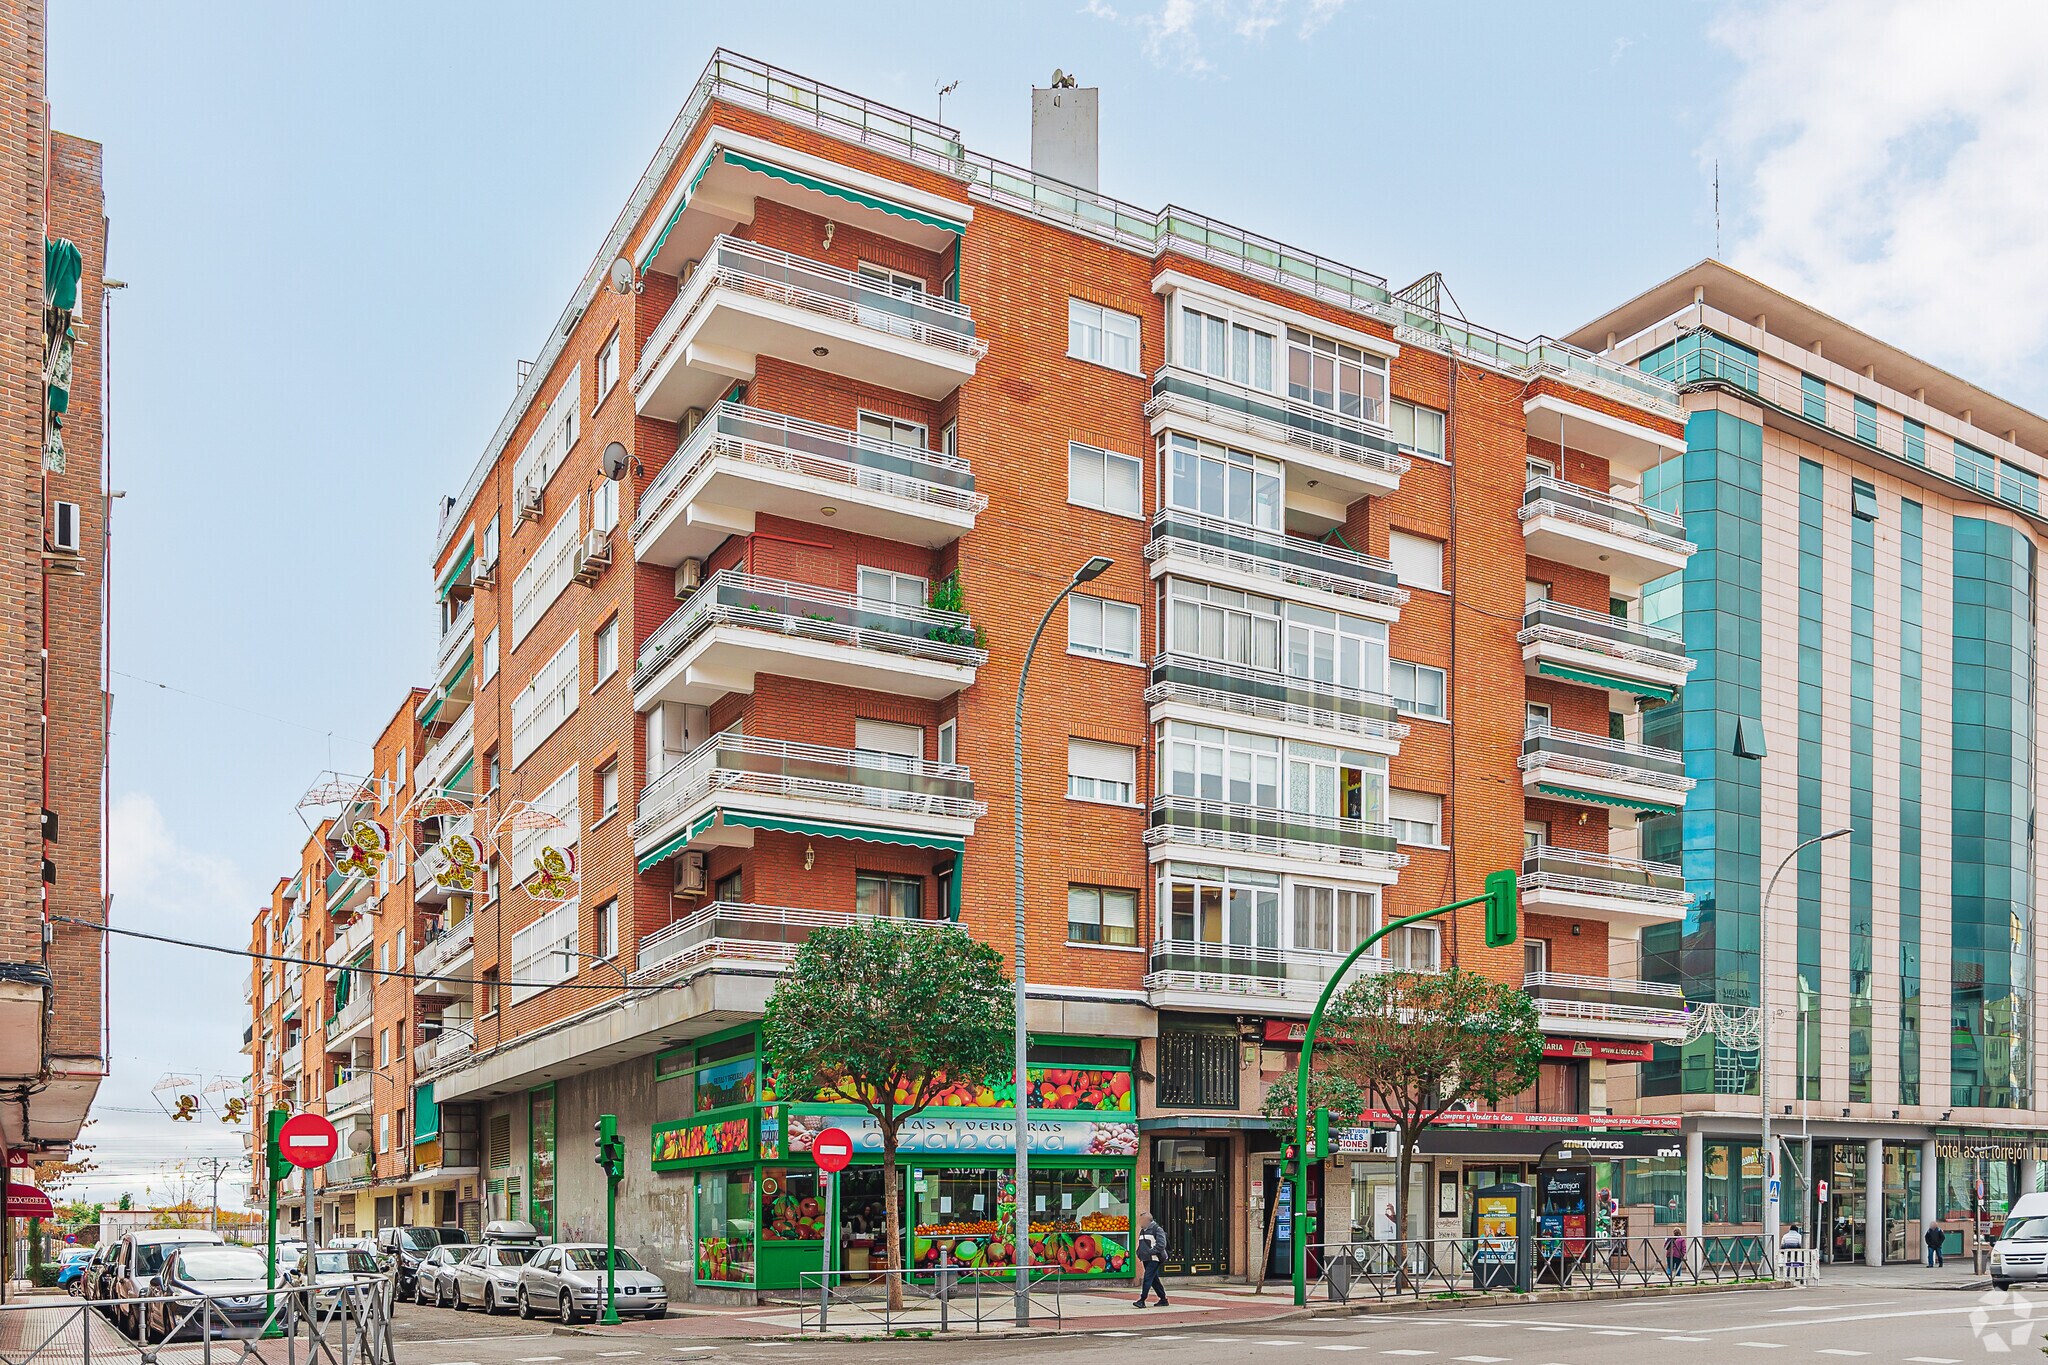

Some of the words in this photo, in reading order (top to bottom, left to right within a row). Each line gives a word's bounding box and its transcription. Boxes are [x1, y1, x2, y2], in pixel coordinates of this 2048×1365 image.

[1440, 1112, 1466, 1122] Comprar
[1466, 1114, 1471, 1122] y
[1472, 1112, 1492, 1121] Vender
[1589, 1116, 1619, 1125] Trabajamos
[1632, 1117, 1652, 1125] Realizar
[1661, 1118, 1678, 1126] Sueños
[862, 1118, 936, 1130] FRTAS
[945, 1120, 956, 1130] Y
[965, 1121, 1062, 1133] VERDRAS
[1935, 1139, 1961, 1159] hotel
[1963, 1144, 1989, 1159] aset
[1991, 1142, 2029, 1165] torrejón
